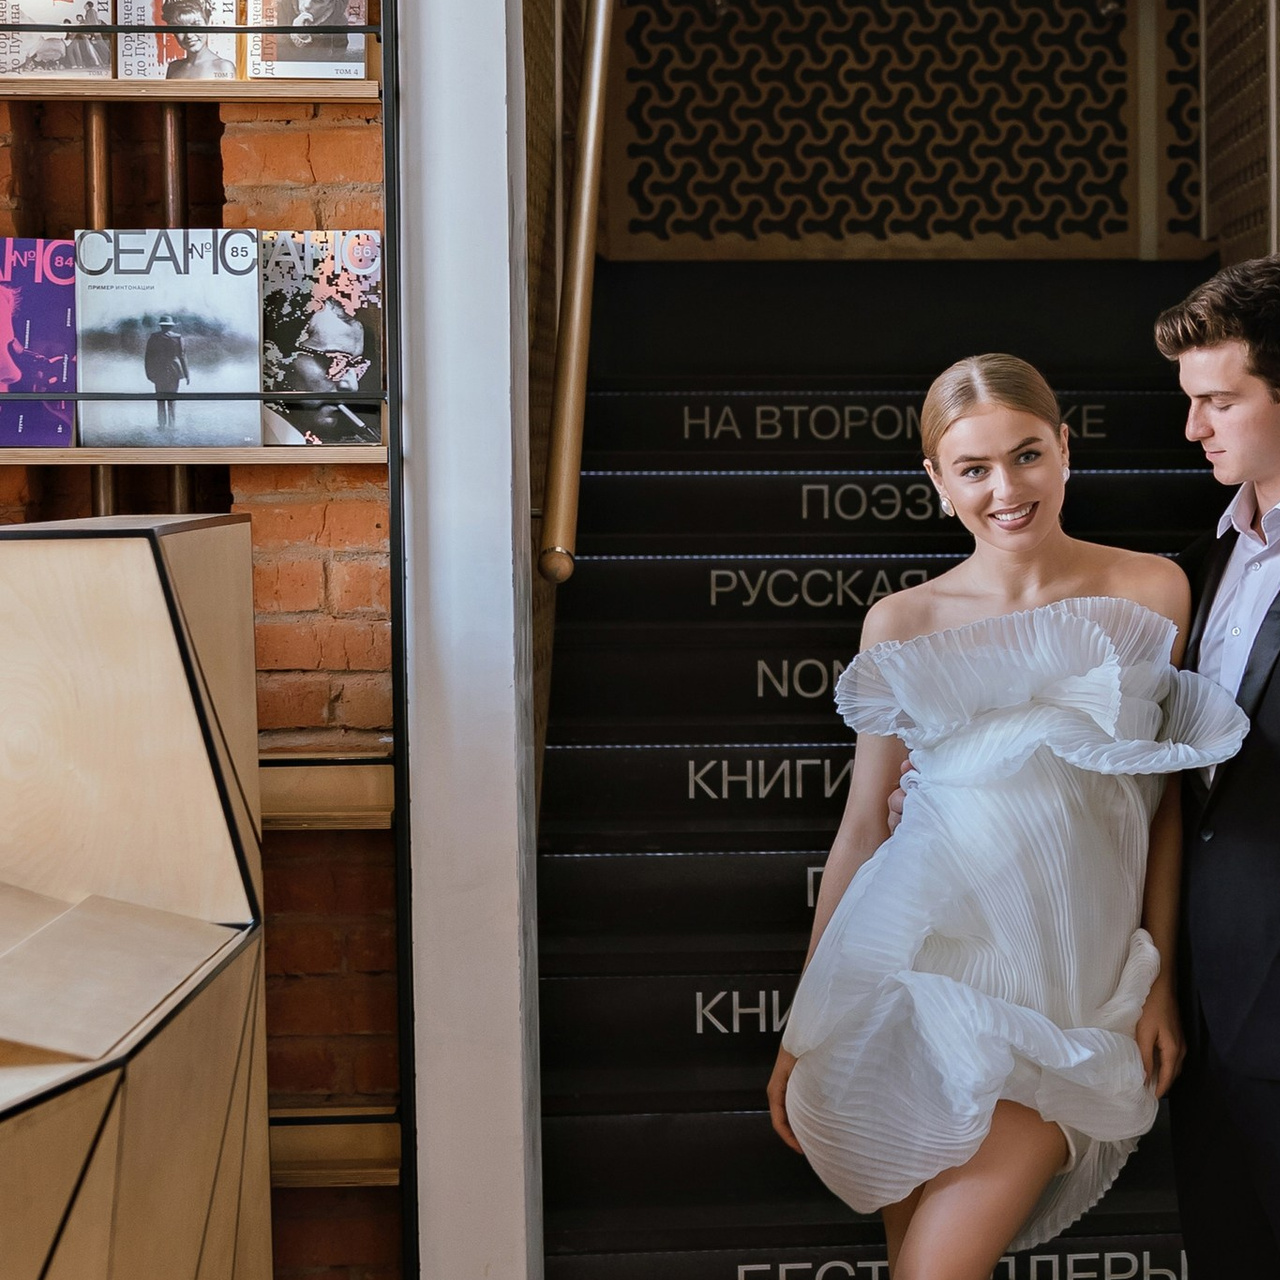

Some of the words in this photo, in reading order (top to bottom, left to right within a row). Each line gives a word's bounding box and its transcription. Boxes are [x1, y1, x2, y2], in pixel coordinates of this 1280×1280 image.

[135, 5, 149, 56] Путна
[263, 6, 277, 57] Путна
[54, 255, 75, 268] 84
[75, 230, 258, 276] СЕАНС
[230, 246, 249, 258] 85
[352, 245, 371, 258] 86
[683, 405, 742, 440] НА
[688, 759, 855, 799] КНИГИ
